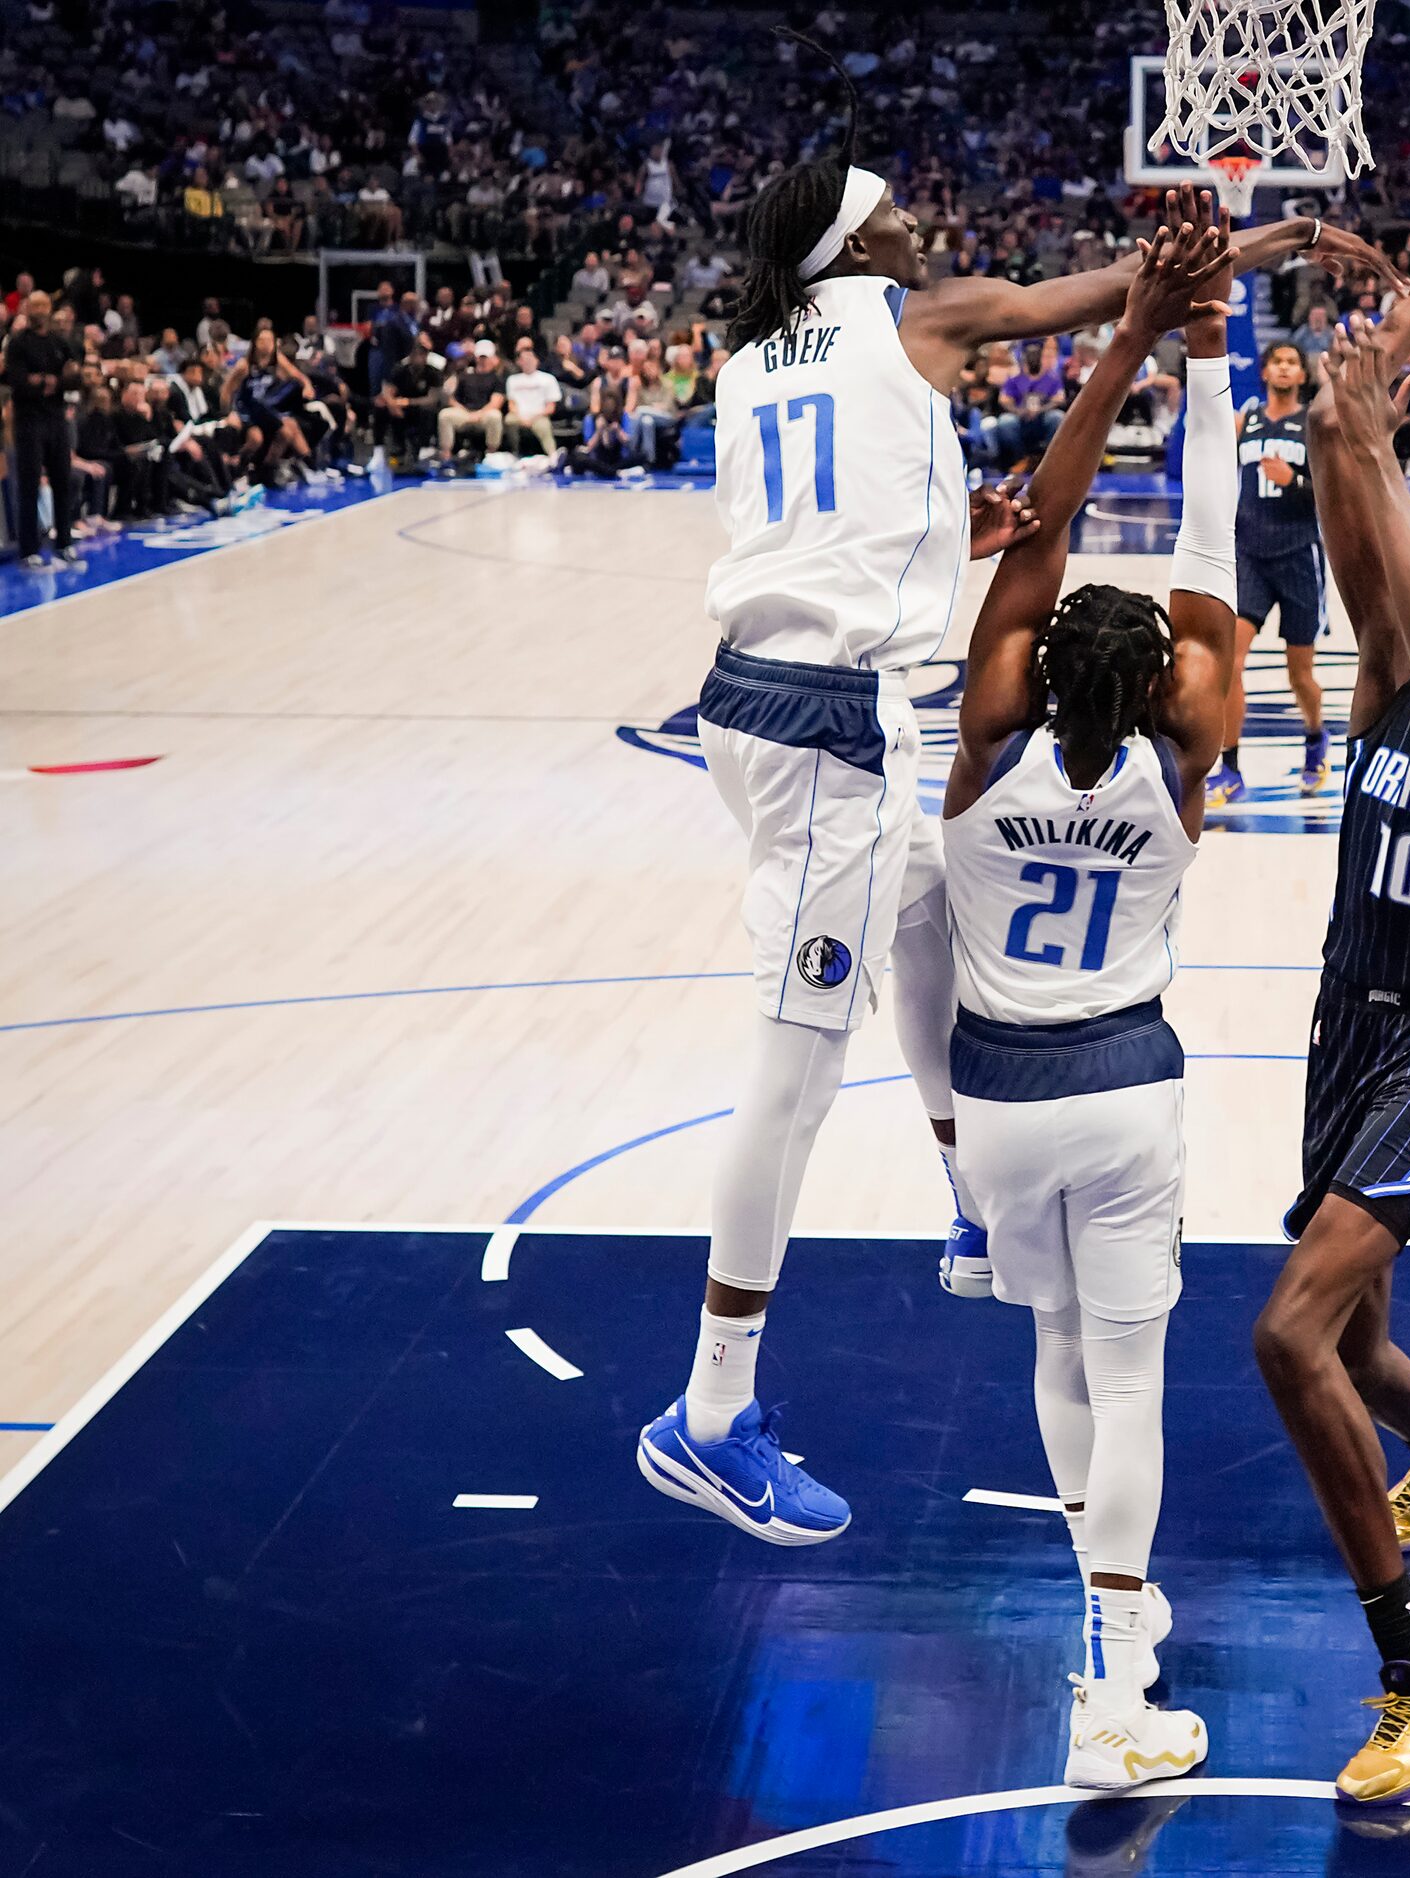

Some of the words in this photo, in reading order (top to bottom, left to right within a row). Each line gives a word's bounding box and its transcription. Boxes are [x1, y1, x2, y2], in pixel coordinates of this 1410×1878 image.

[763, 326, 841, 373] GUEYE
[752, 392, 836, 523] 17
[994, 816, 1153, 866] NTILIKINA
[1004, 861, 1122, 971] 21
